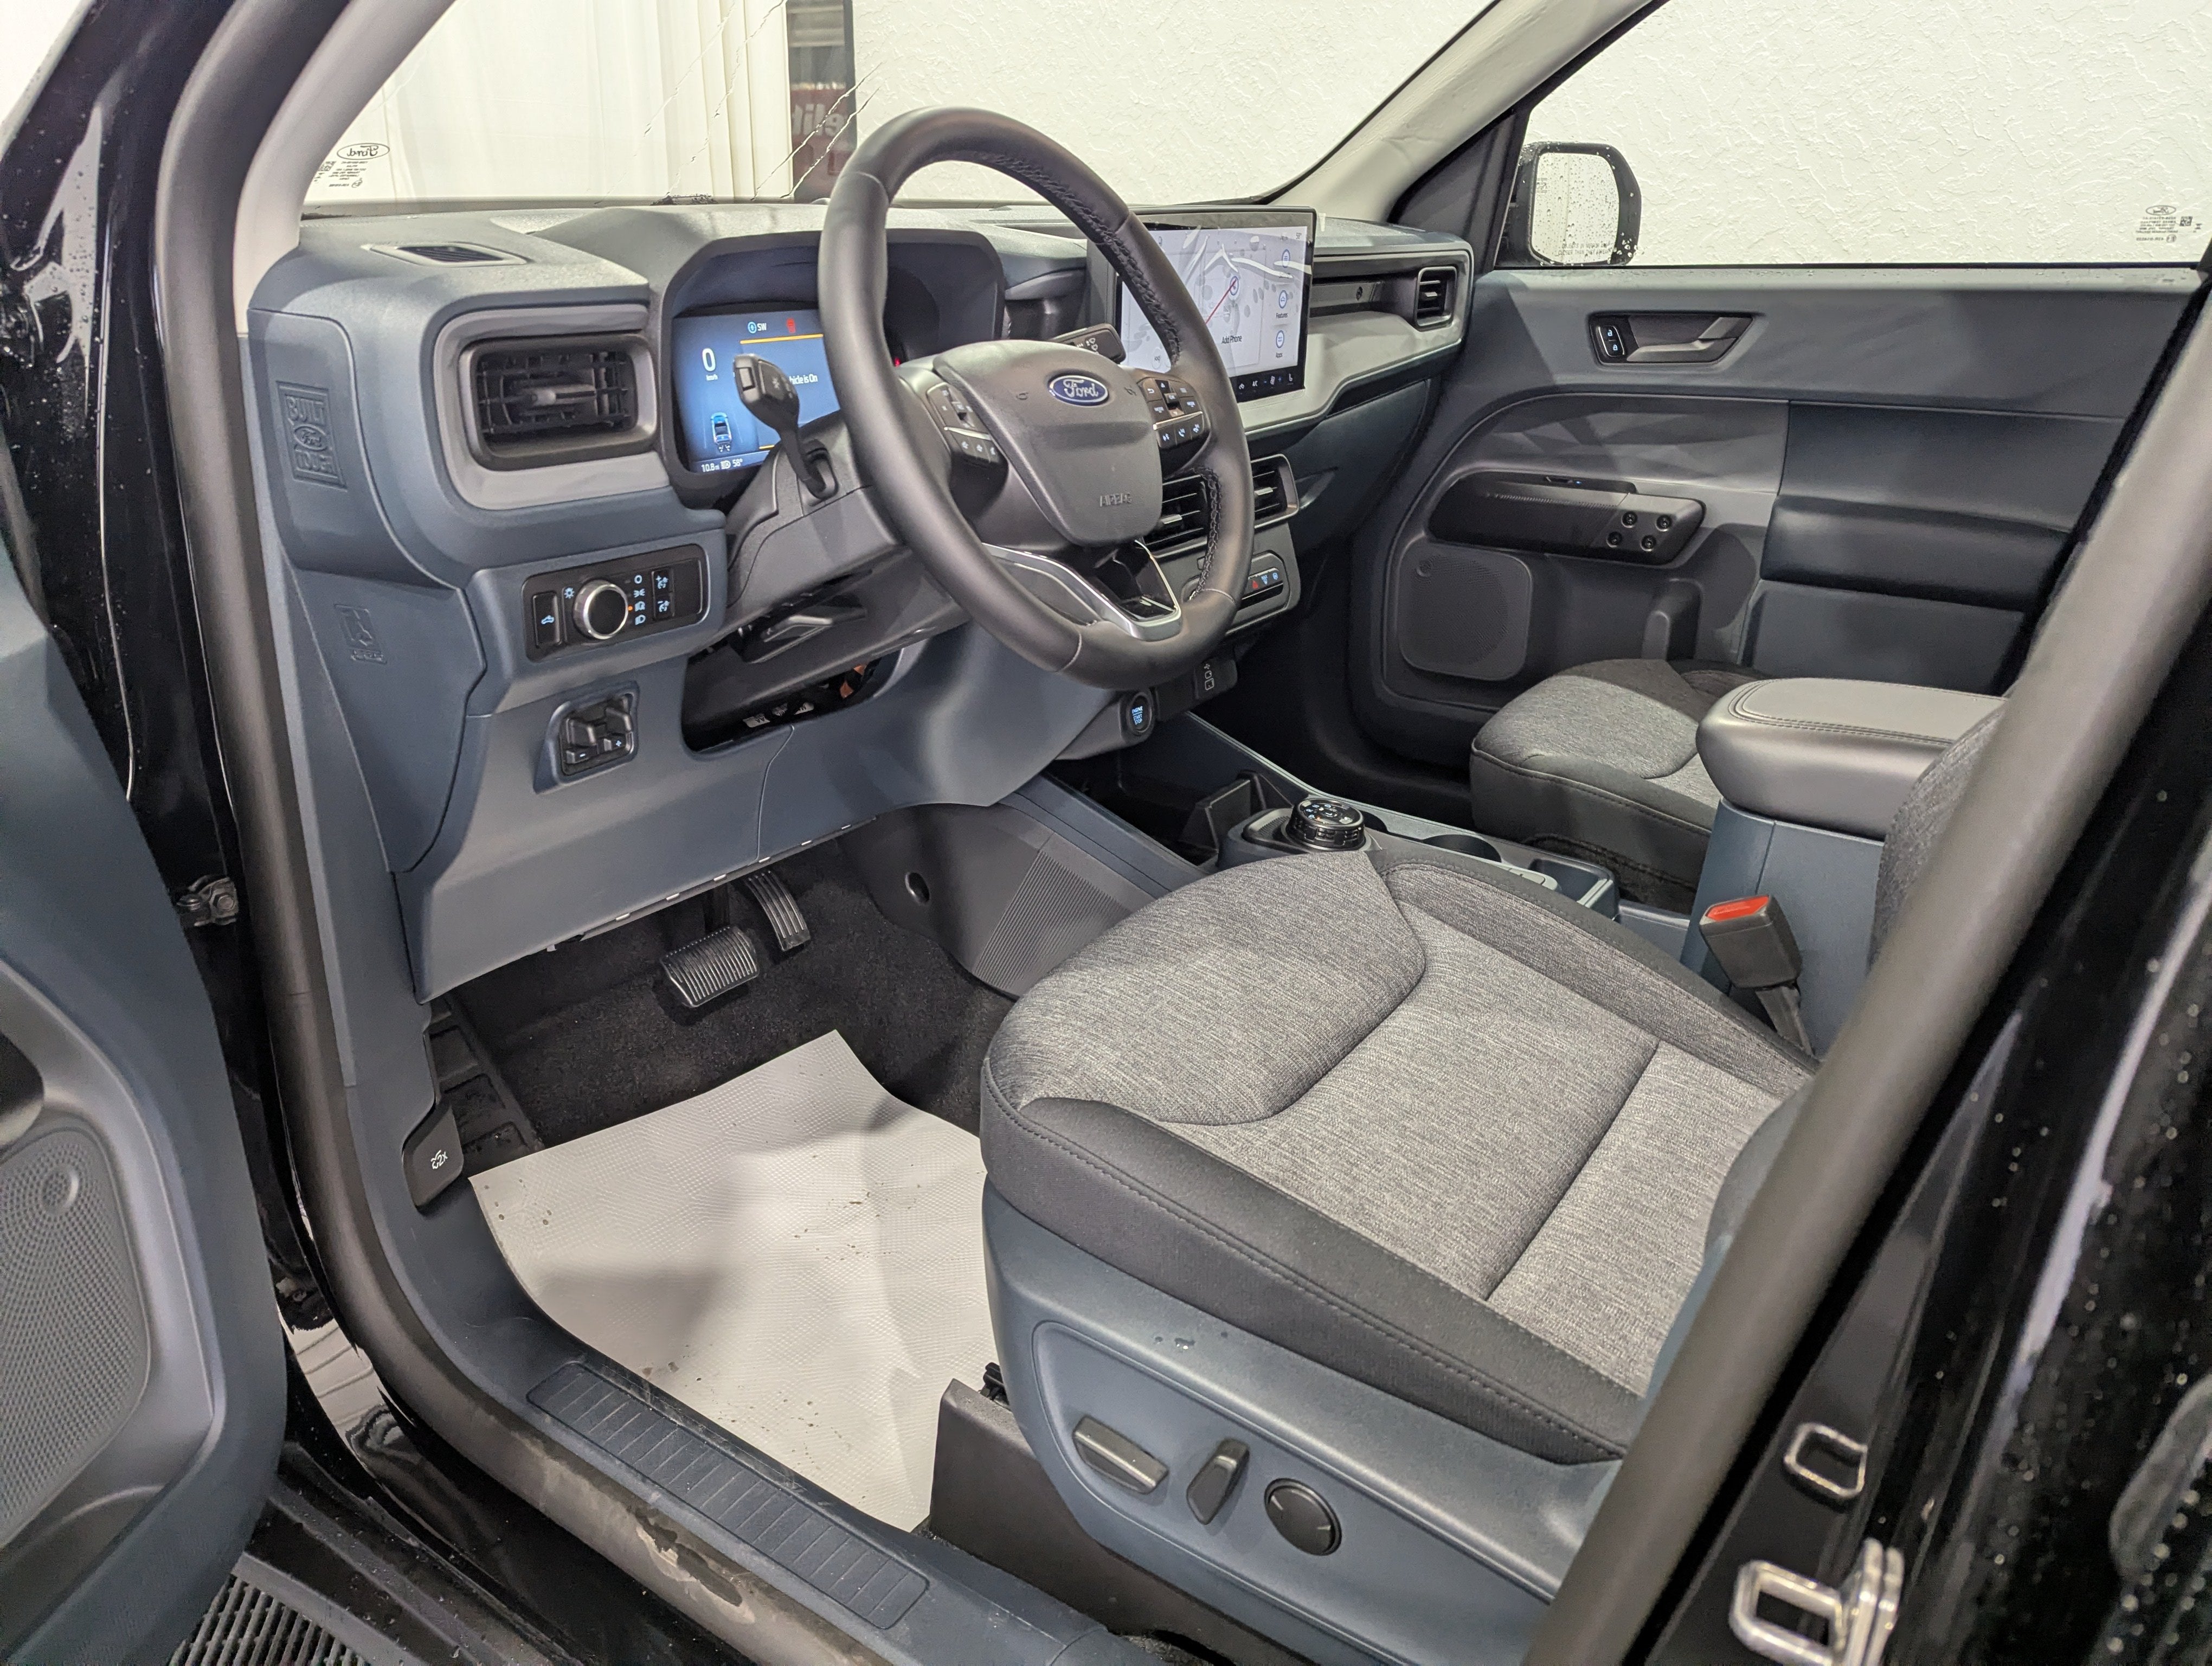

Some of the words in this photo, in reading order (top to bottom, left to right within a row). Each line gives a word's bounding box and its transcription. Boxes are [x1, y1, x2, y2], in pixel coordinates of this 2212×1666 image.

[757, 323, 767, 331] SW
[1221, 336, 1230, 344] Add
[1230, 335, 1242, 343] Phone
[702, 348, 716, 371] 0
[809, 373, 818, 383] On
[1063, 379, 1099, 398] Ford
[286, 395, 325, 425] BUILT
